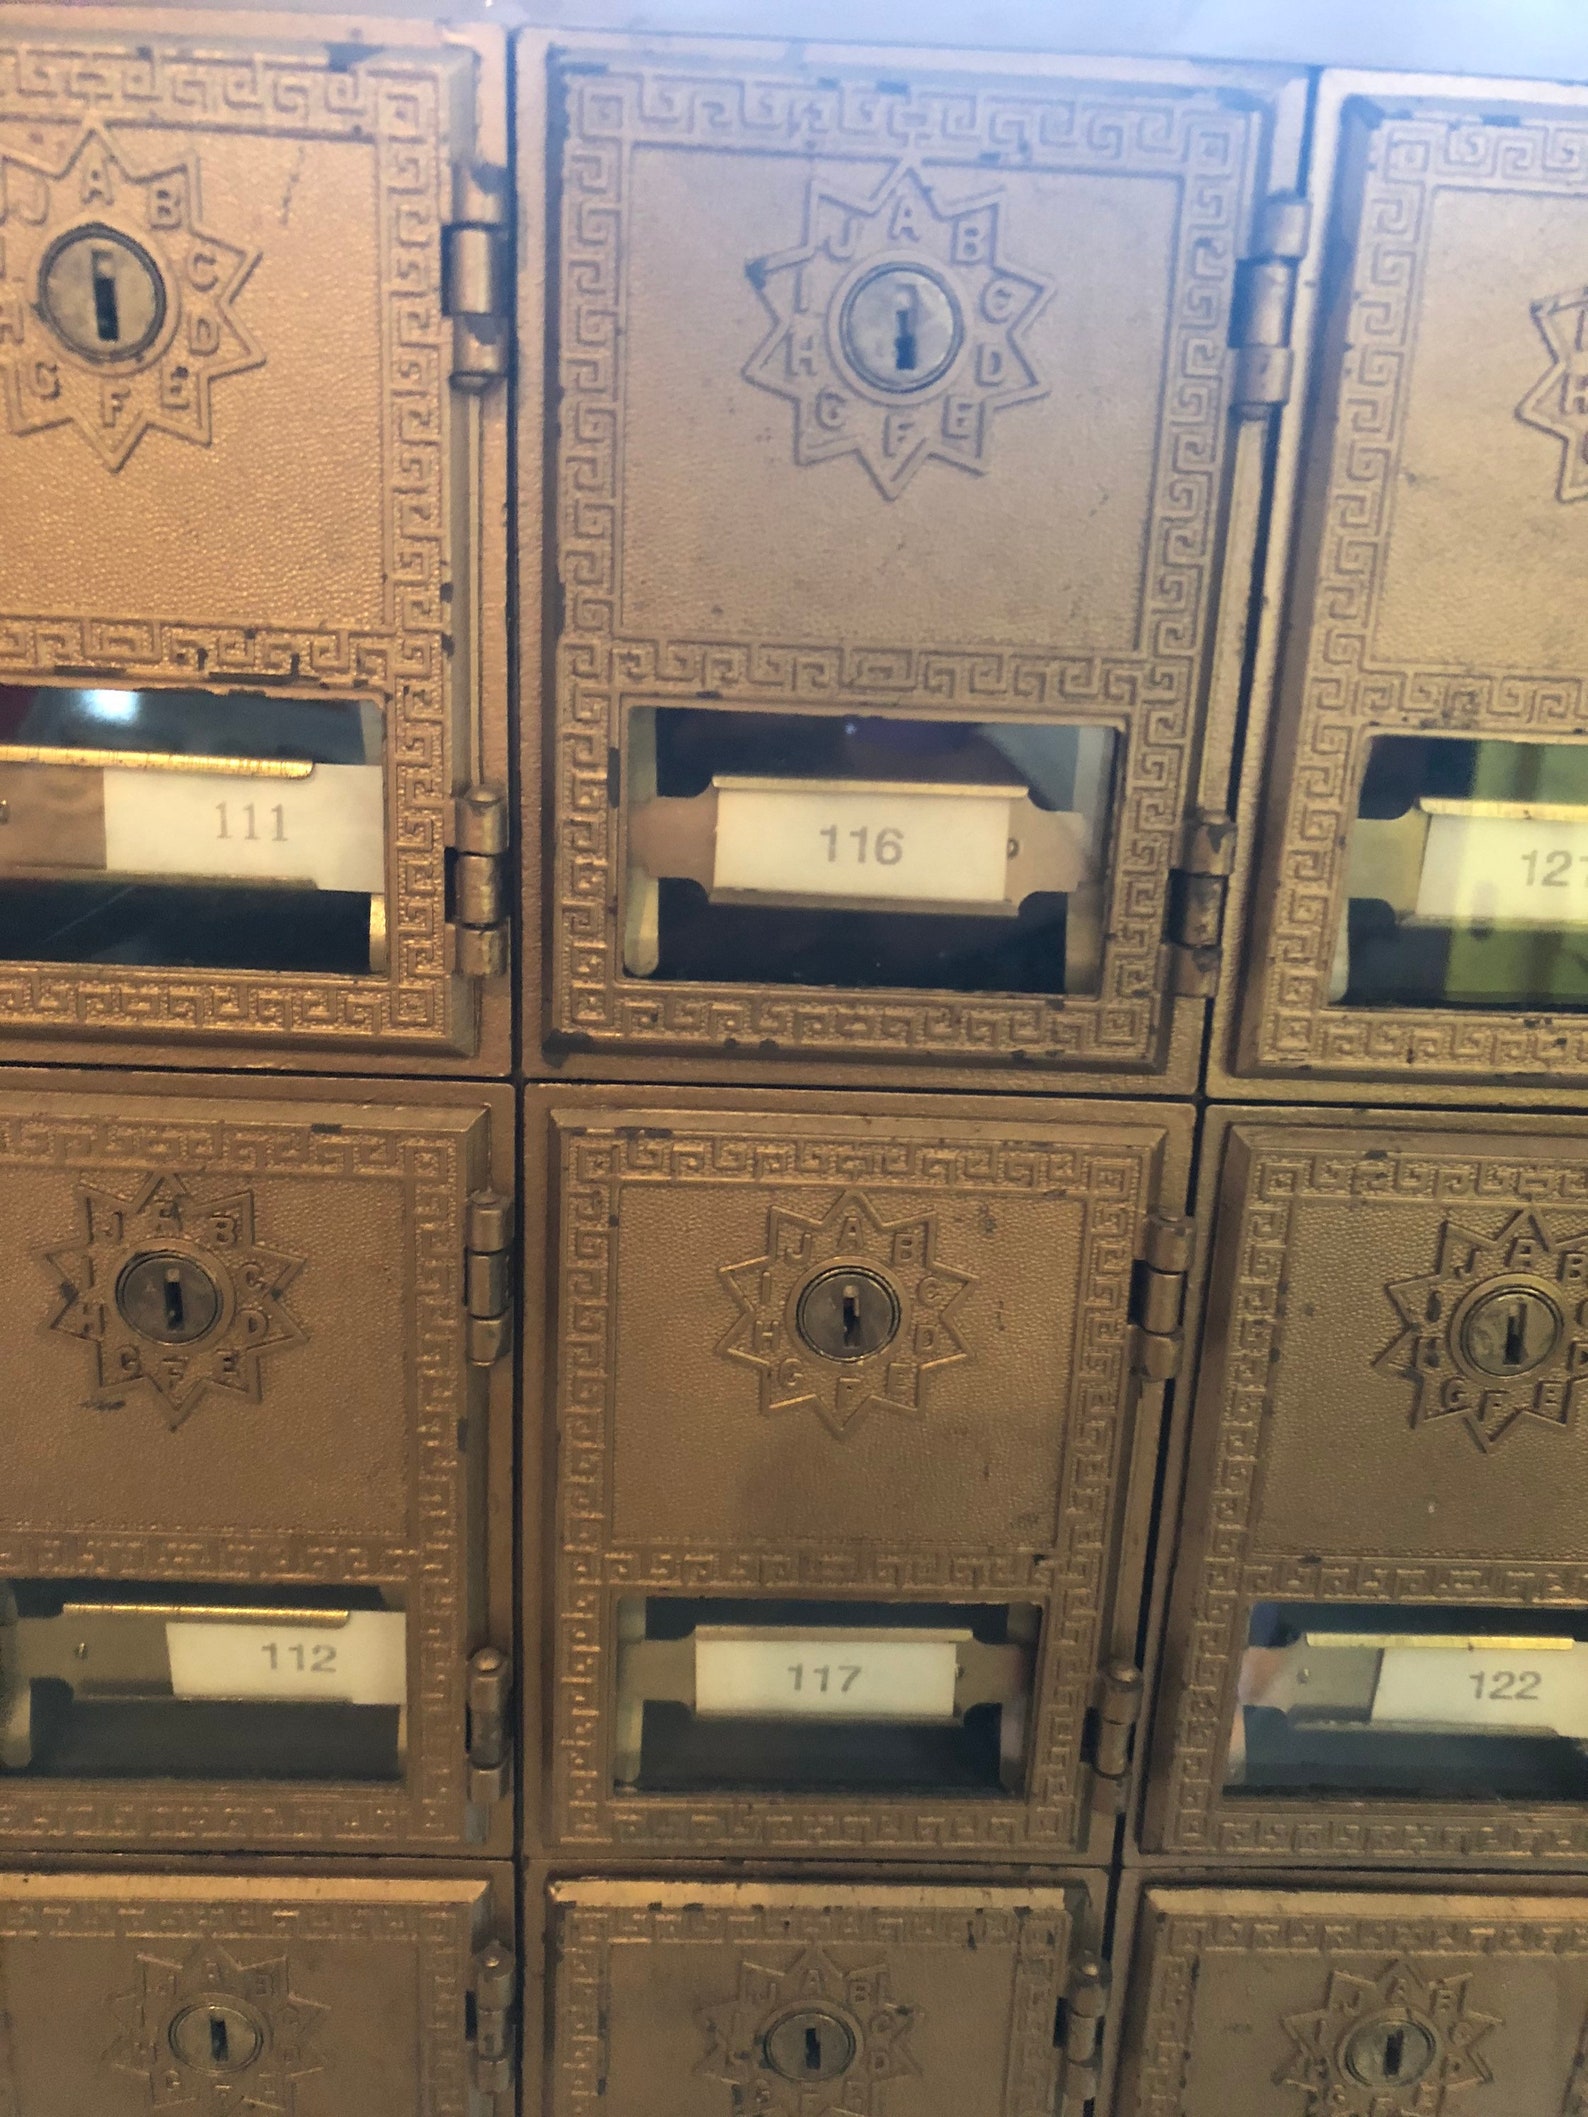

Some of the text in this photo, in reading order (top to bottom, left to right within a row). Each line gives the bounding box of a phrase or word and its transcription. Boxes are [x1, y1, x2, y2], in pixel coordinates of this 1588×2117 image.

[785, 194, 1011, 457] A B C D E F G H I J
[215, 801, 289, 842] 111
[820, 824, 904, 866] 116
[261, 1643, 337, 1673] 112
[787, 1663, 862, 1693] 117
[1469, 1670, 1541, 1700] 122
